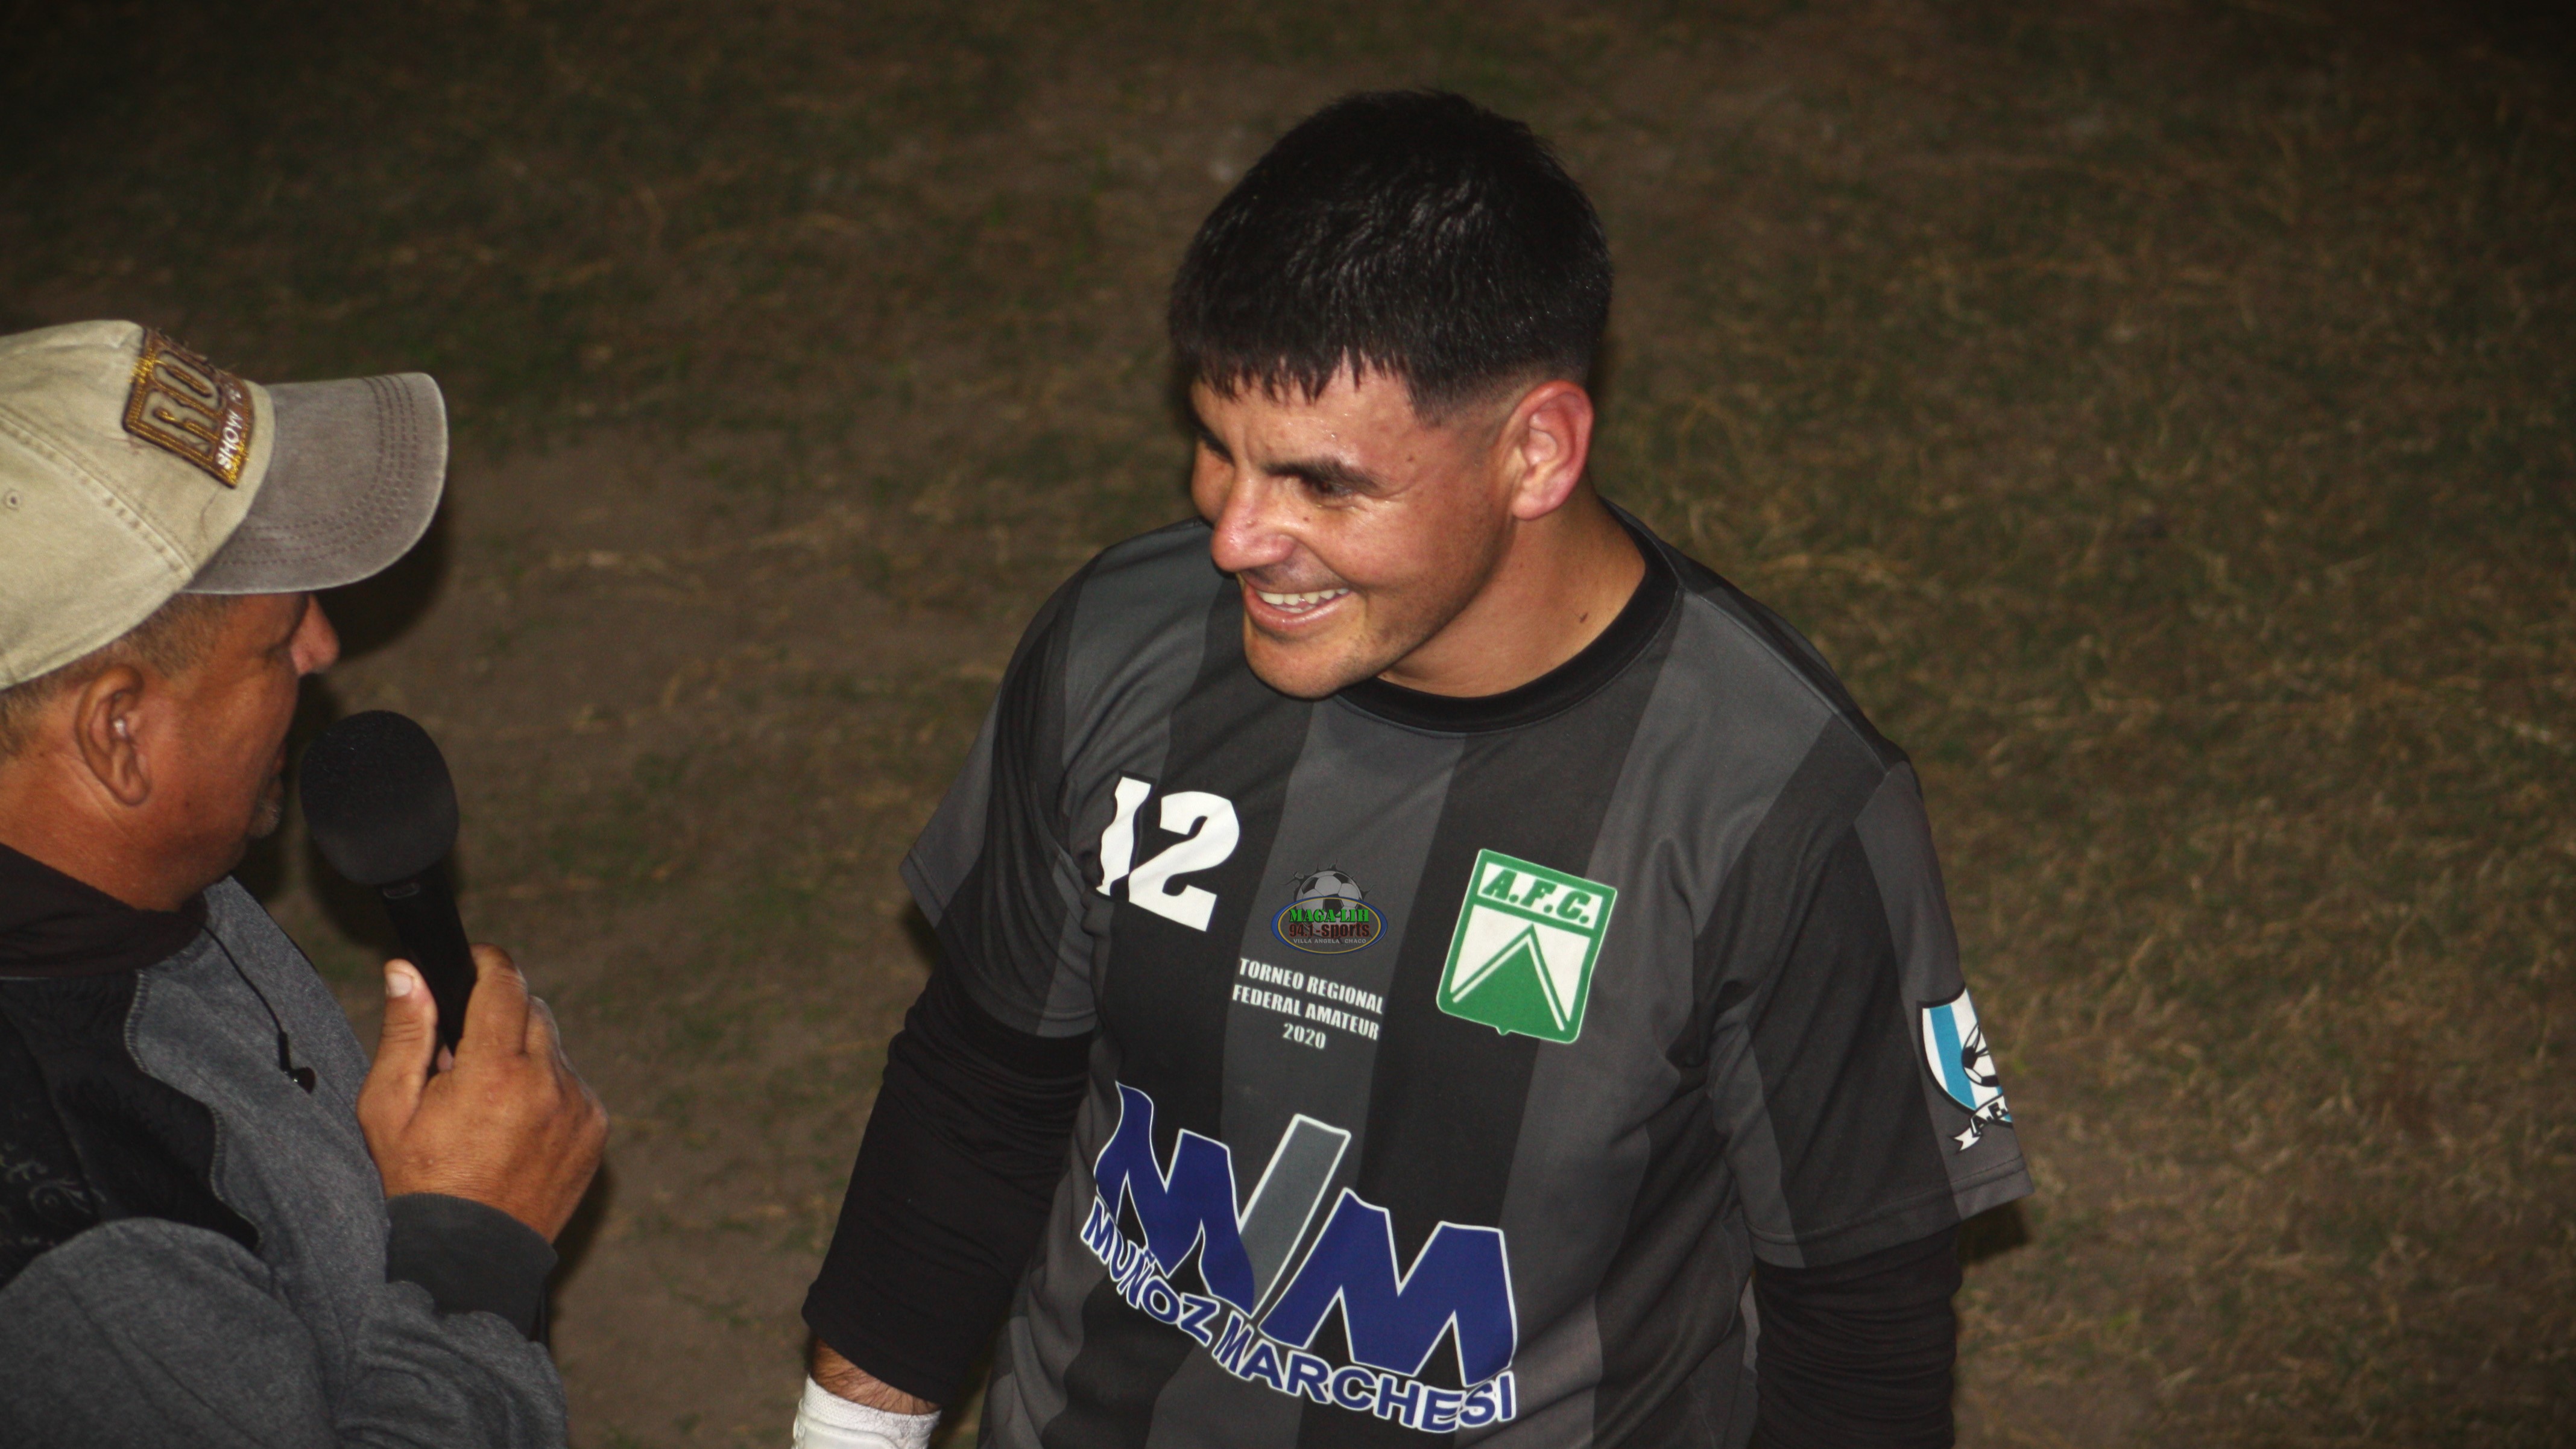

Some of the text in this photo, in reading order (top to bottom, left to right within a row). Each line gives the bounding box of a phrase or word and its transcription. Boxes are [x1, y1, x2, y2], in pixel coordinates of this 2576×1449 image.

[216, 408, 244, 470] SHOW
[1096, 775, 1240, 932] 12
[1481, 869, 1592, 924] A.F.C.
[1232, 984, 1380, 1041] FEDERAL AMATEUR
[1239, 957, 1383, 1015] TORNEO REGIONAL
[1282, 1022, 1327, 1050] 2020
[1080, 1195, 1517, 1433] MUÑOZ MARCHESI
